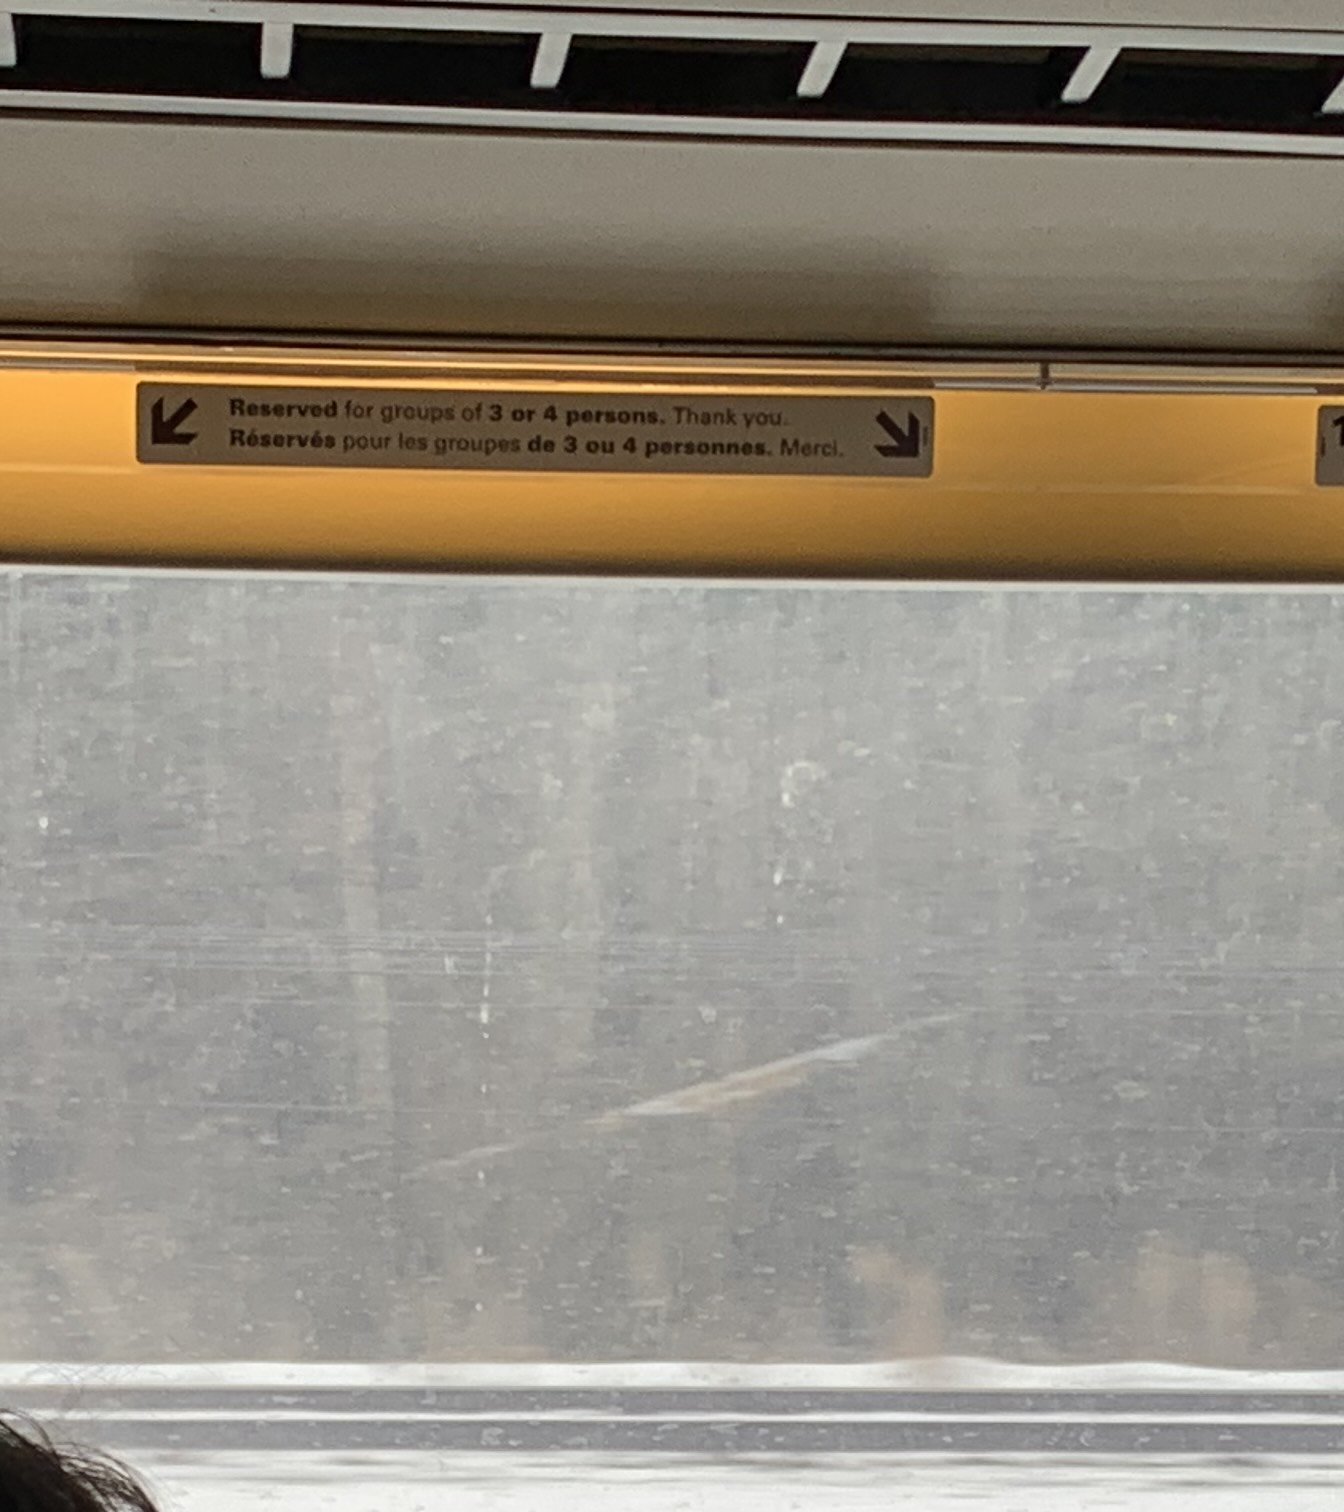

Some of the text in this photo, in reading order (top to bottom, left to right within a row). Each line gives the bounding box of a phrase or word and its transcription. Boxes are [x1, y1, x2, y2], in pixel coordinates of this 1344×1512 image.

[229, 398, 788, 431] Reserved for groups of 3 or 4 persons. Thank you.
[229, 427, 844, 459] Réservés pour les groupes de 3 ou 4 personnes. Merci.
